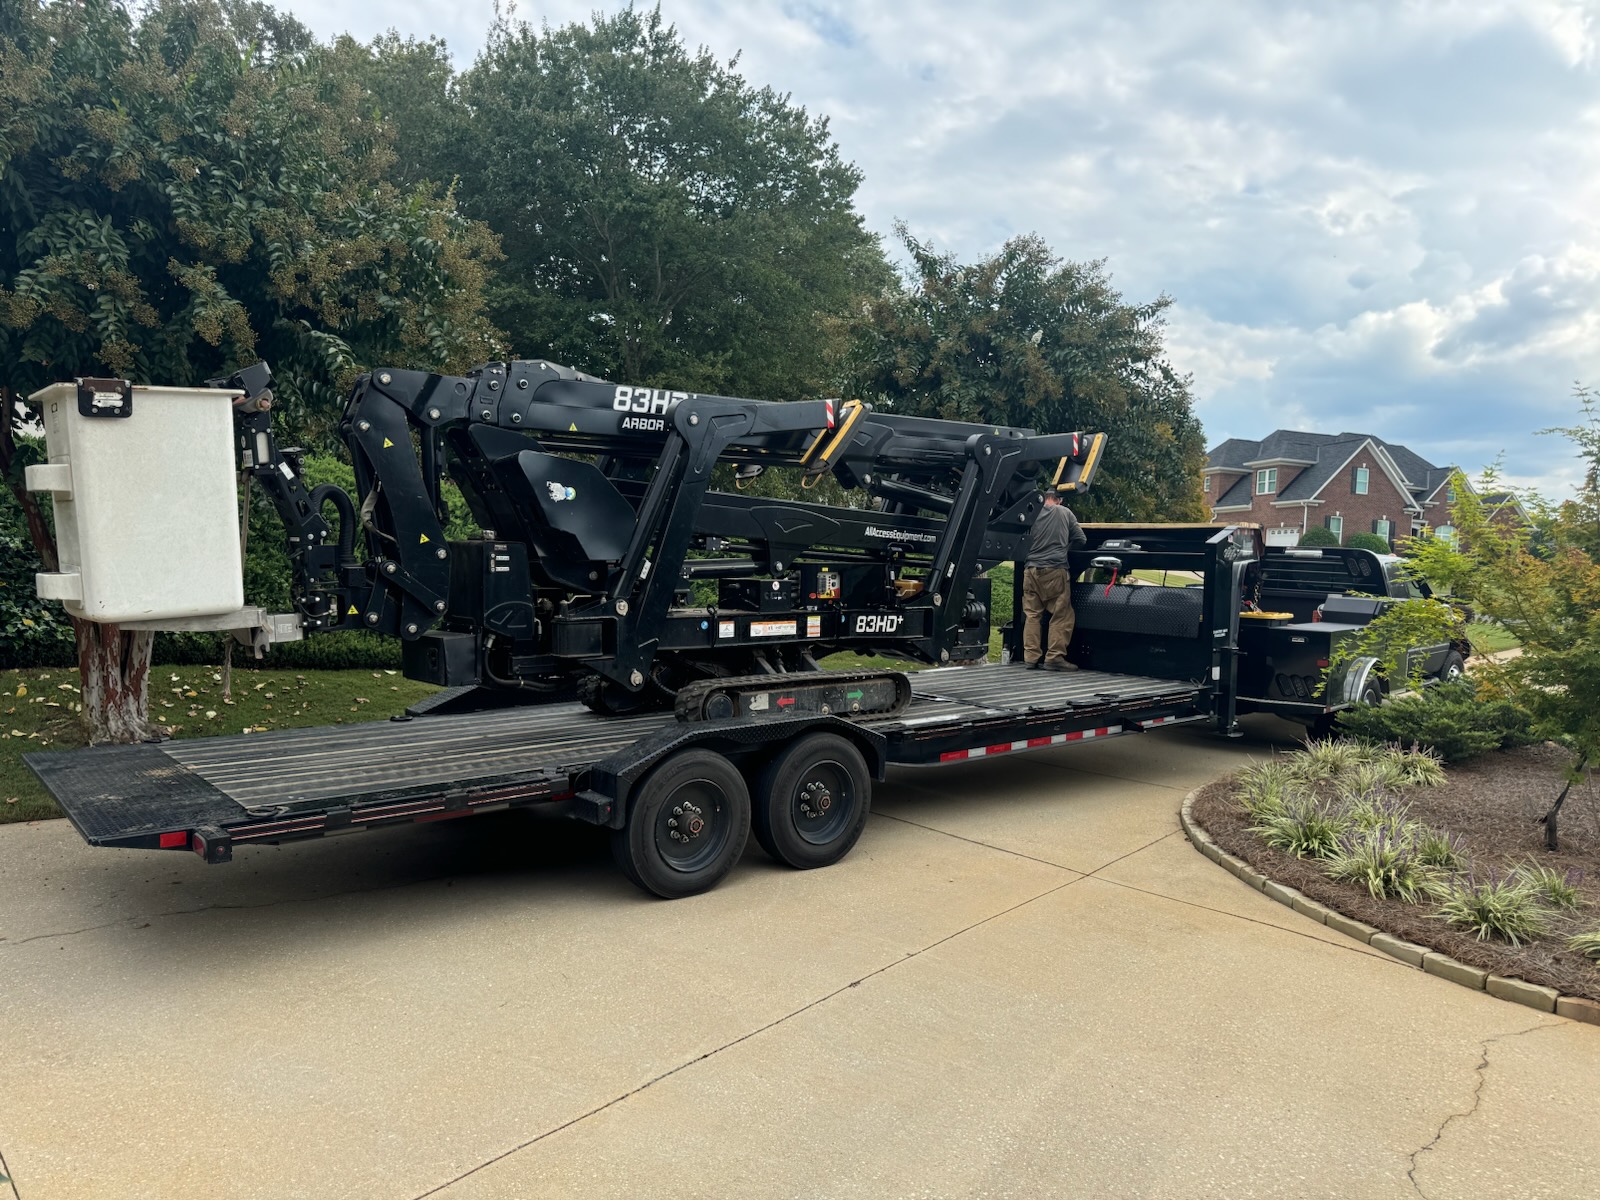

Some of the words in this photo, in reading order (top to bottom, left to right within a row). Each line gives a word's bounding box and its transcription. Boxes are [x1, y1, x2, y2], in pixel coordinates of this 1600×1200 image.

[613, 386, 697, 415] 83H
[621, 417, 665, 431] ARBOR
[864, 526, 937, 543] AllAccessEquipment.com
[855, 615, 904, 633] 83HD+
